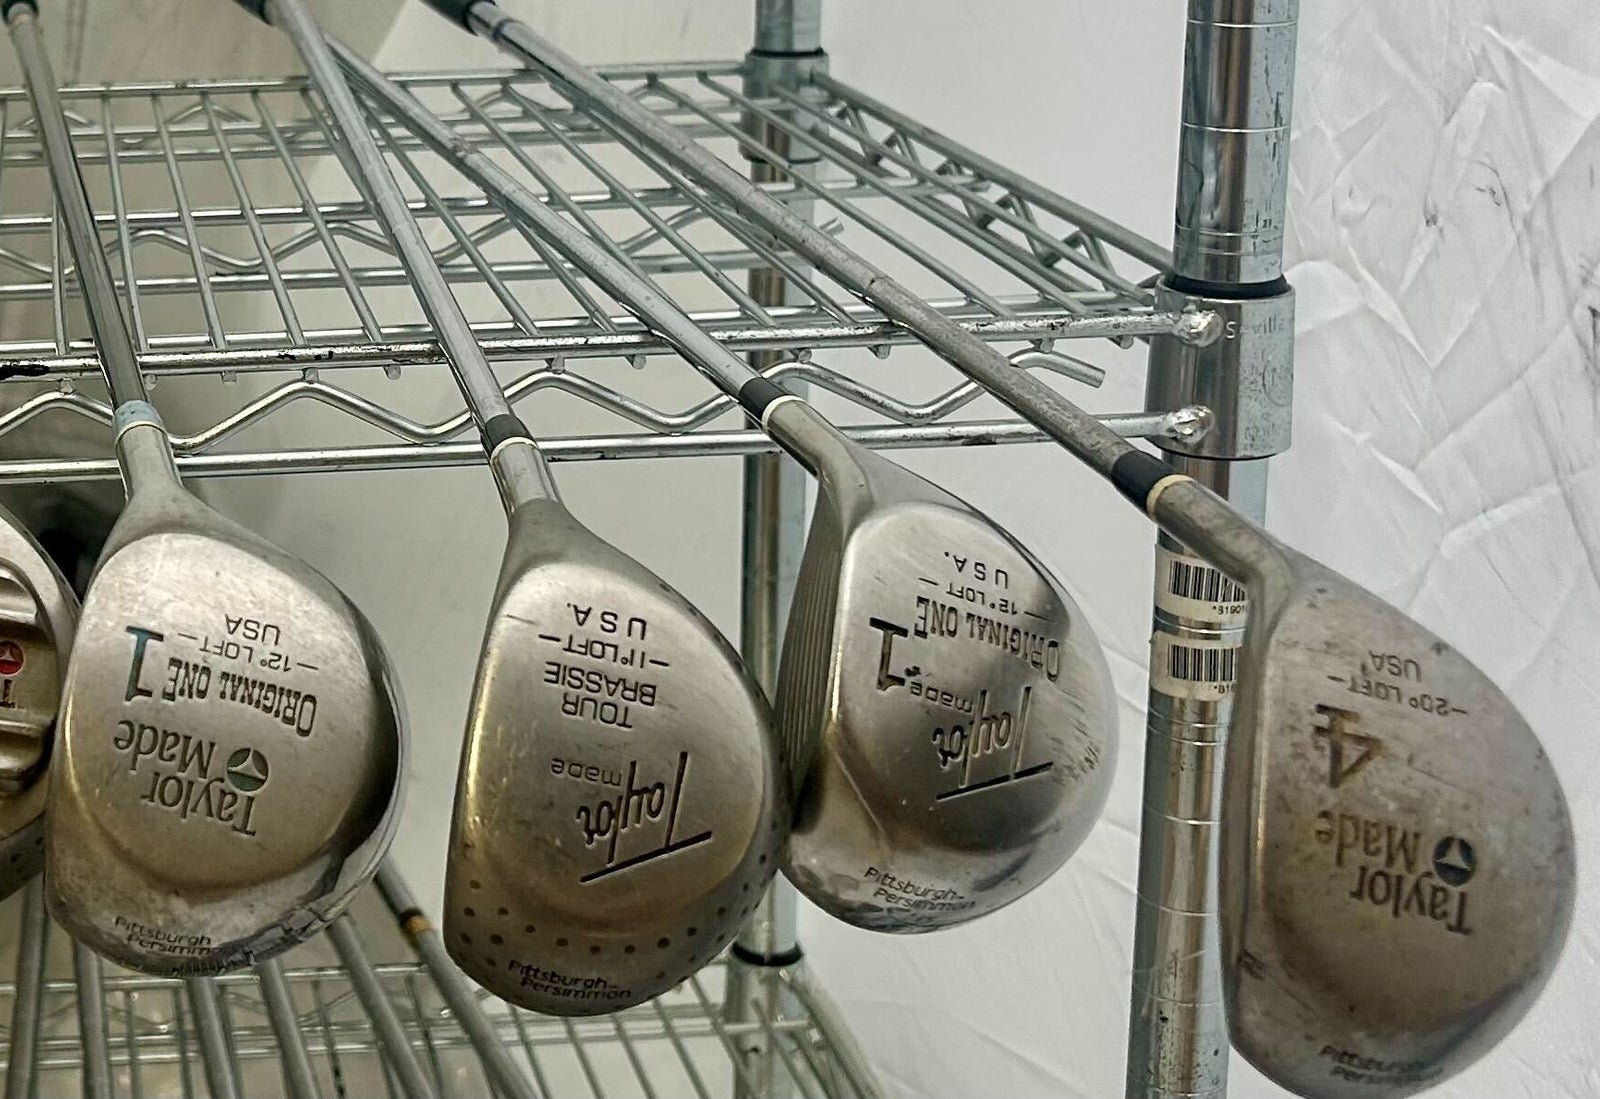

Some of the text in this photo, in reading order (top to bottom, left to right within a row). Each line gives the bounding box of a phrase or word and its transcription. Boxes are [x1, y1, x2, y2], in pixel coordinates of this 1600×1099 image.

[225, 613, 281, 646] USA
[869, 617, 909, 692] 1
[914, 595, 1060, 682] ORIGINAL ONE
[126, 625, 164, 702] 1
[544, 661, 656, 707] BRASSIE
[1369, 650, 1422, 683] USA
[162, 656, 317, 737] ORIGINAL ONE
[561, 693, 633, 729] TOUR
[113, 719, 216, 779] Made
[909, 681, 1053, 801] Taylor made
[141, 771, 257, 836] Taylor
[551, 752, 712, 884] Taylor made
[1315, 809, 1422, 874] Made
[873, 886, 977, 912] Persimmon
[1350, 864, 1474, 936] Taylor
[115, 915, 211, 946] Pittsburgh
[127, 933, 216, 955] Persimm
[520, 976, 631, 1000] Persimmon
